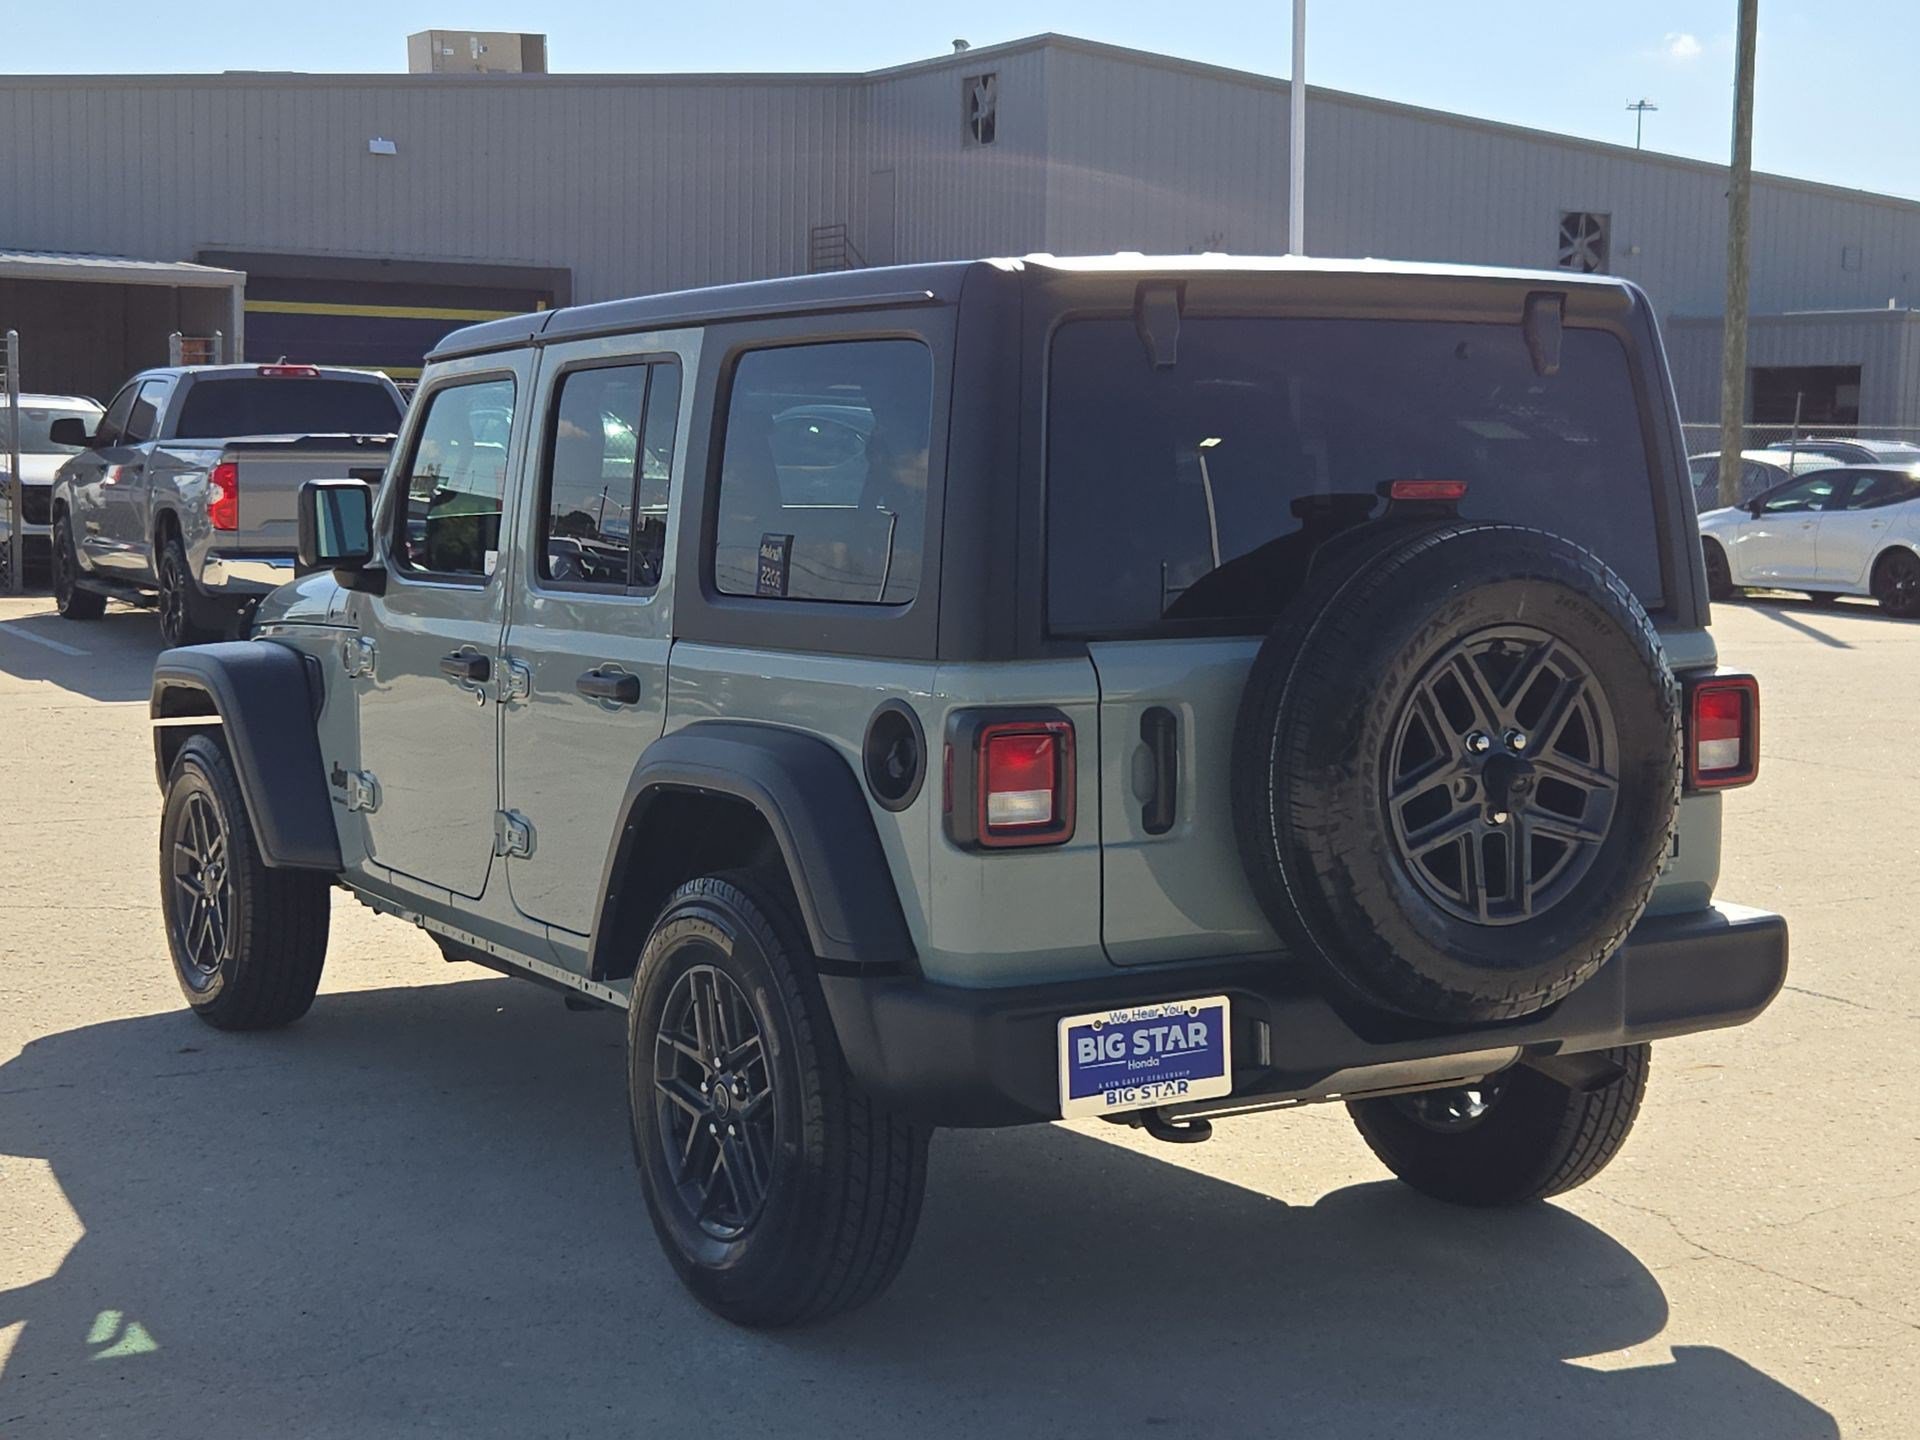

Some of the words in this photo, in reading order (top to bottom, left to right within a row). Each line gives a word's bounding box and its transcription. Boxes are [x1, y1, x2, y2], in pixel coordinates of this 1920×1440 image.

[1109, 1012, 1128, 1023] We
[1131, 1007, 1159, 1020] Hear
[1162, 1004, 1183, 1016] You
[1077, 1033, 1126, 1064] BIG
[1132, 1022, 1208, 1055] STAR
[1127, 1056, 1160, 1071] Honda
[1106, 1088, 1136, 1106] BIG
[1141, 1080, 1189, 1100] STAR
